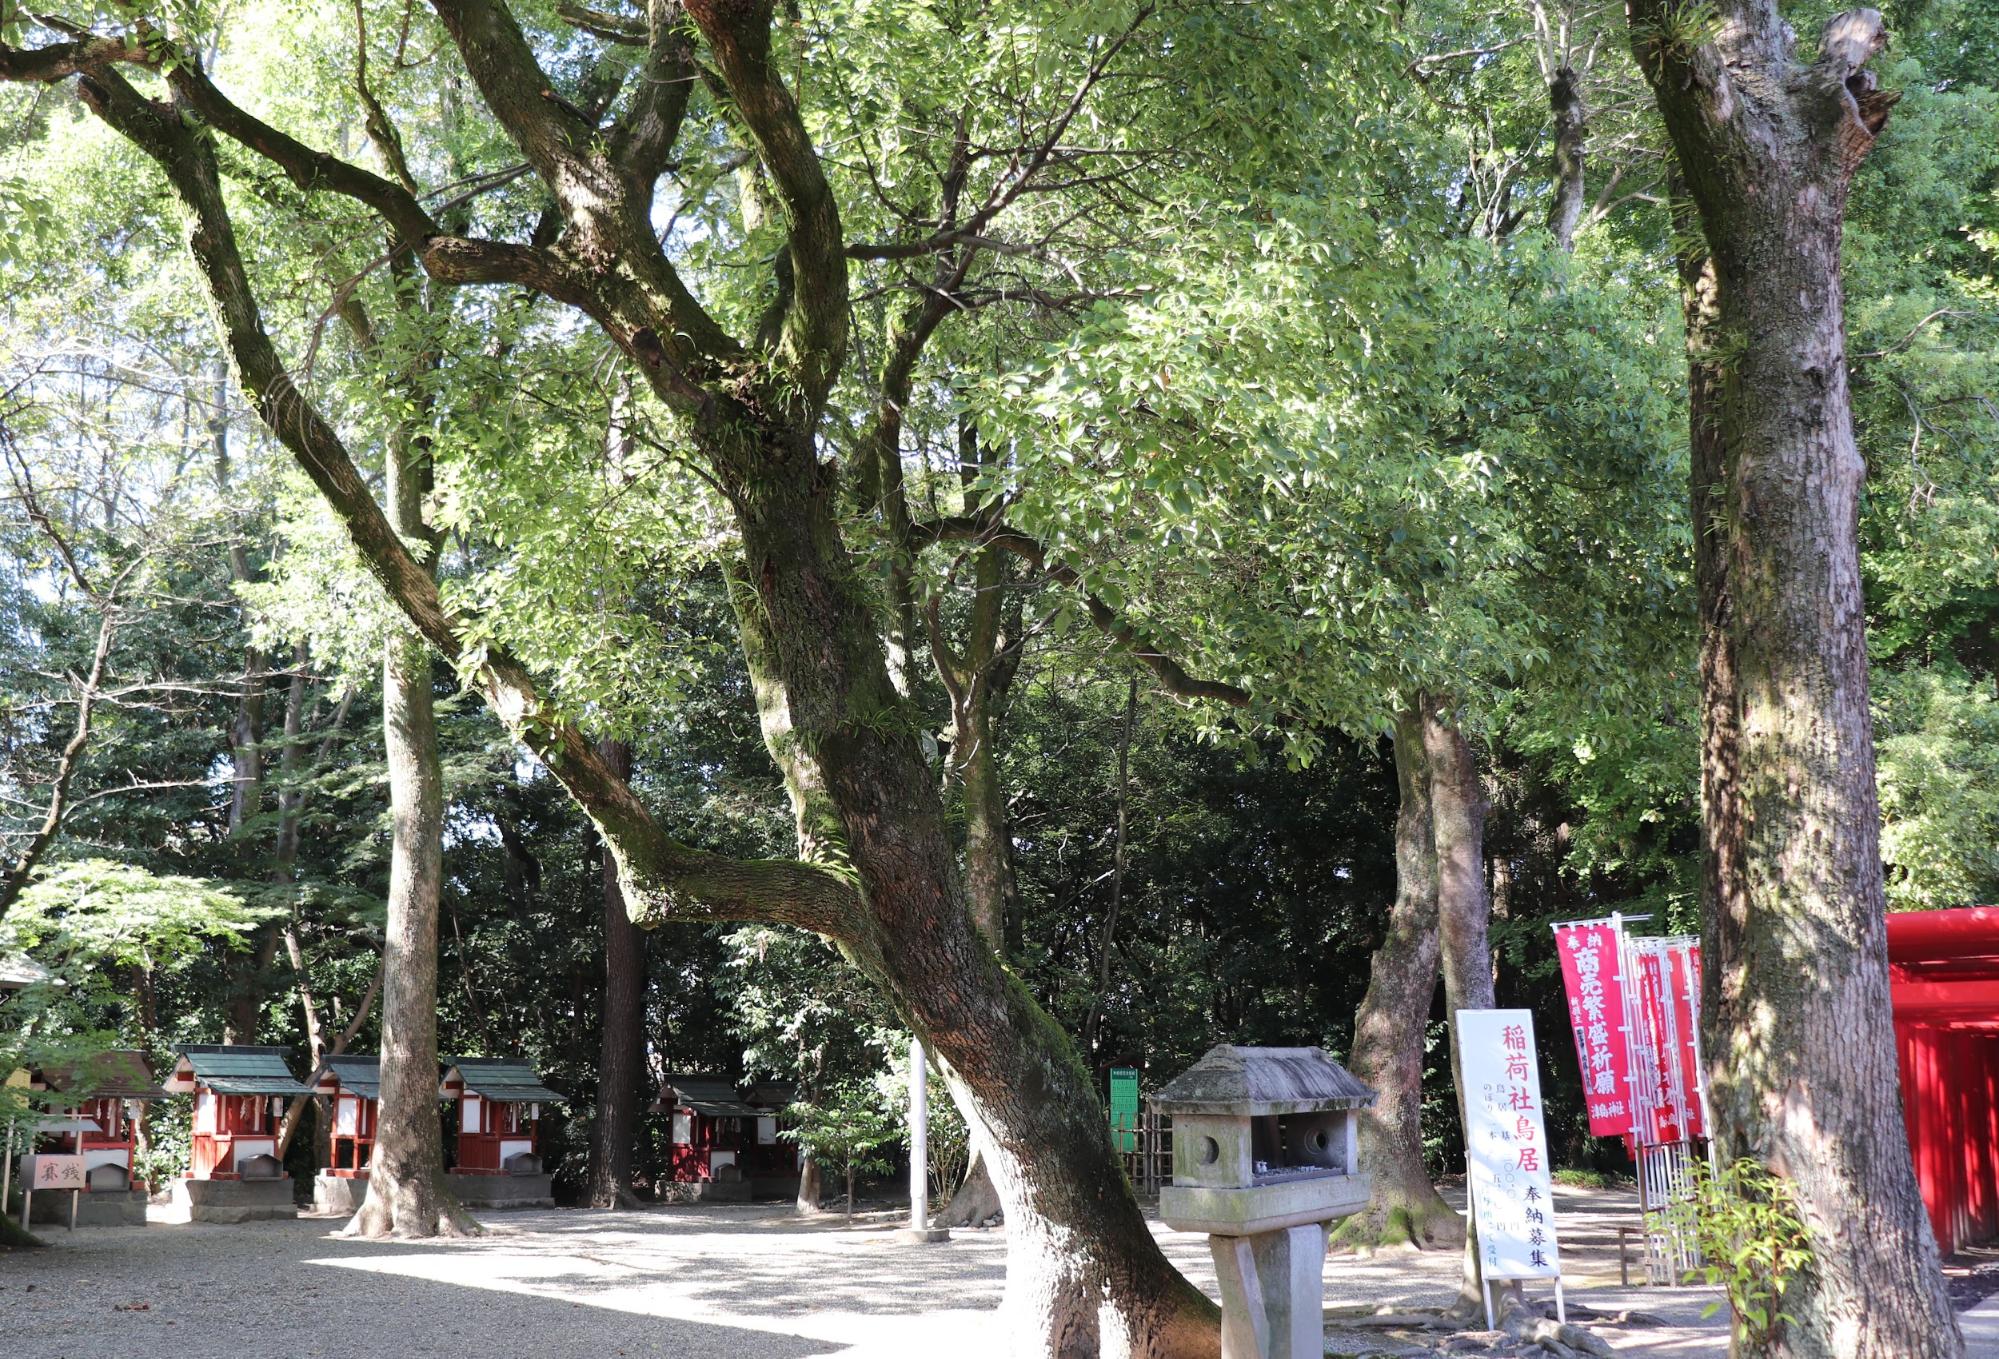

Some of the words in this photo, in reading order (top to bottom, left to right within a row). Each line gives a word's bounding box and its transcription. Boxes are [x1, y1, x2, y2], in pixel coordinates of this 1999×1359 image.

[1573, 947, 1616, 1095] 商売繁盛祈願
[41, 1162, 80, 1181] 賽銭
[1502, 1024, 1539, 1173] 稲荷社鳥居
[1523, 1185, 1549, 1268] 奉納募集
